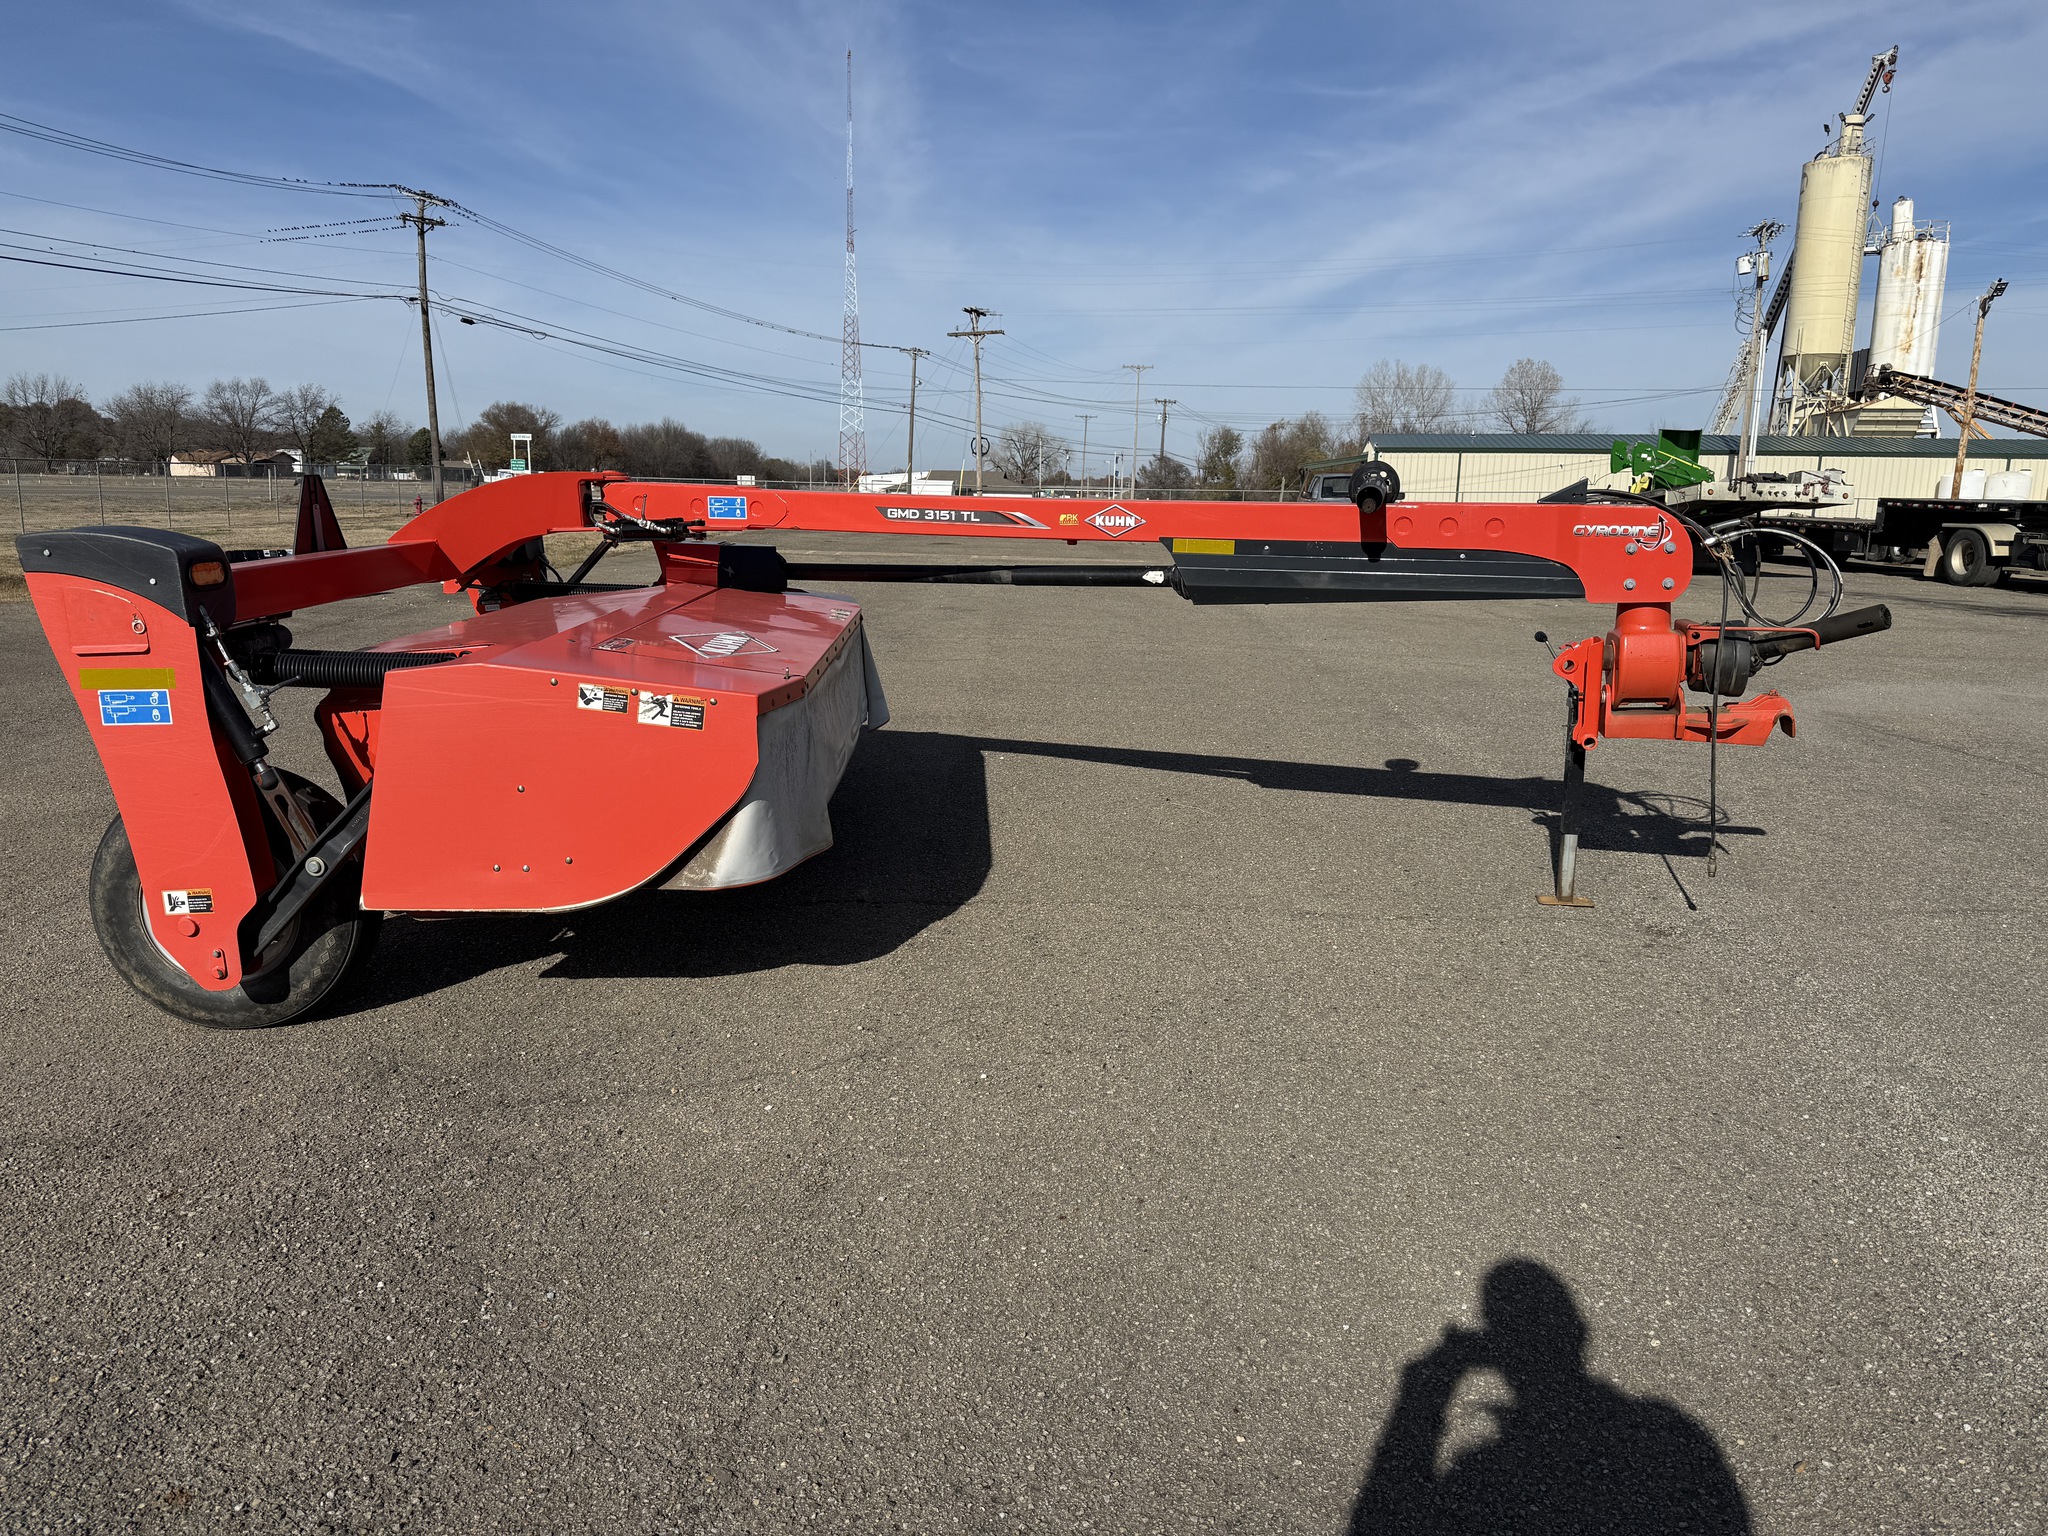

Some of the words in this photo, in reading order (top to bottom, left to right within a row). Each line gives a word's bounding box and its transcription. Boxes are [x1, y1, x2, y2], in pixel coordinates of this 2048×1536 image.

[887, 508, 919, 519] GMD
[925, 510, 955, 520] 3151
[961, 511, 980, 521] TL
[1095, 515, 1136, 527] KUHN
